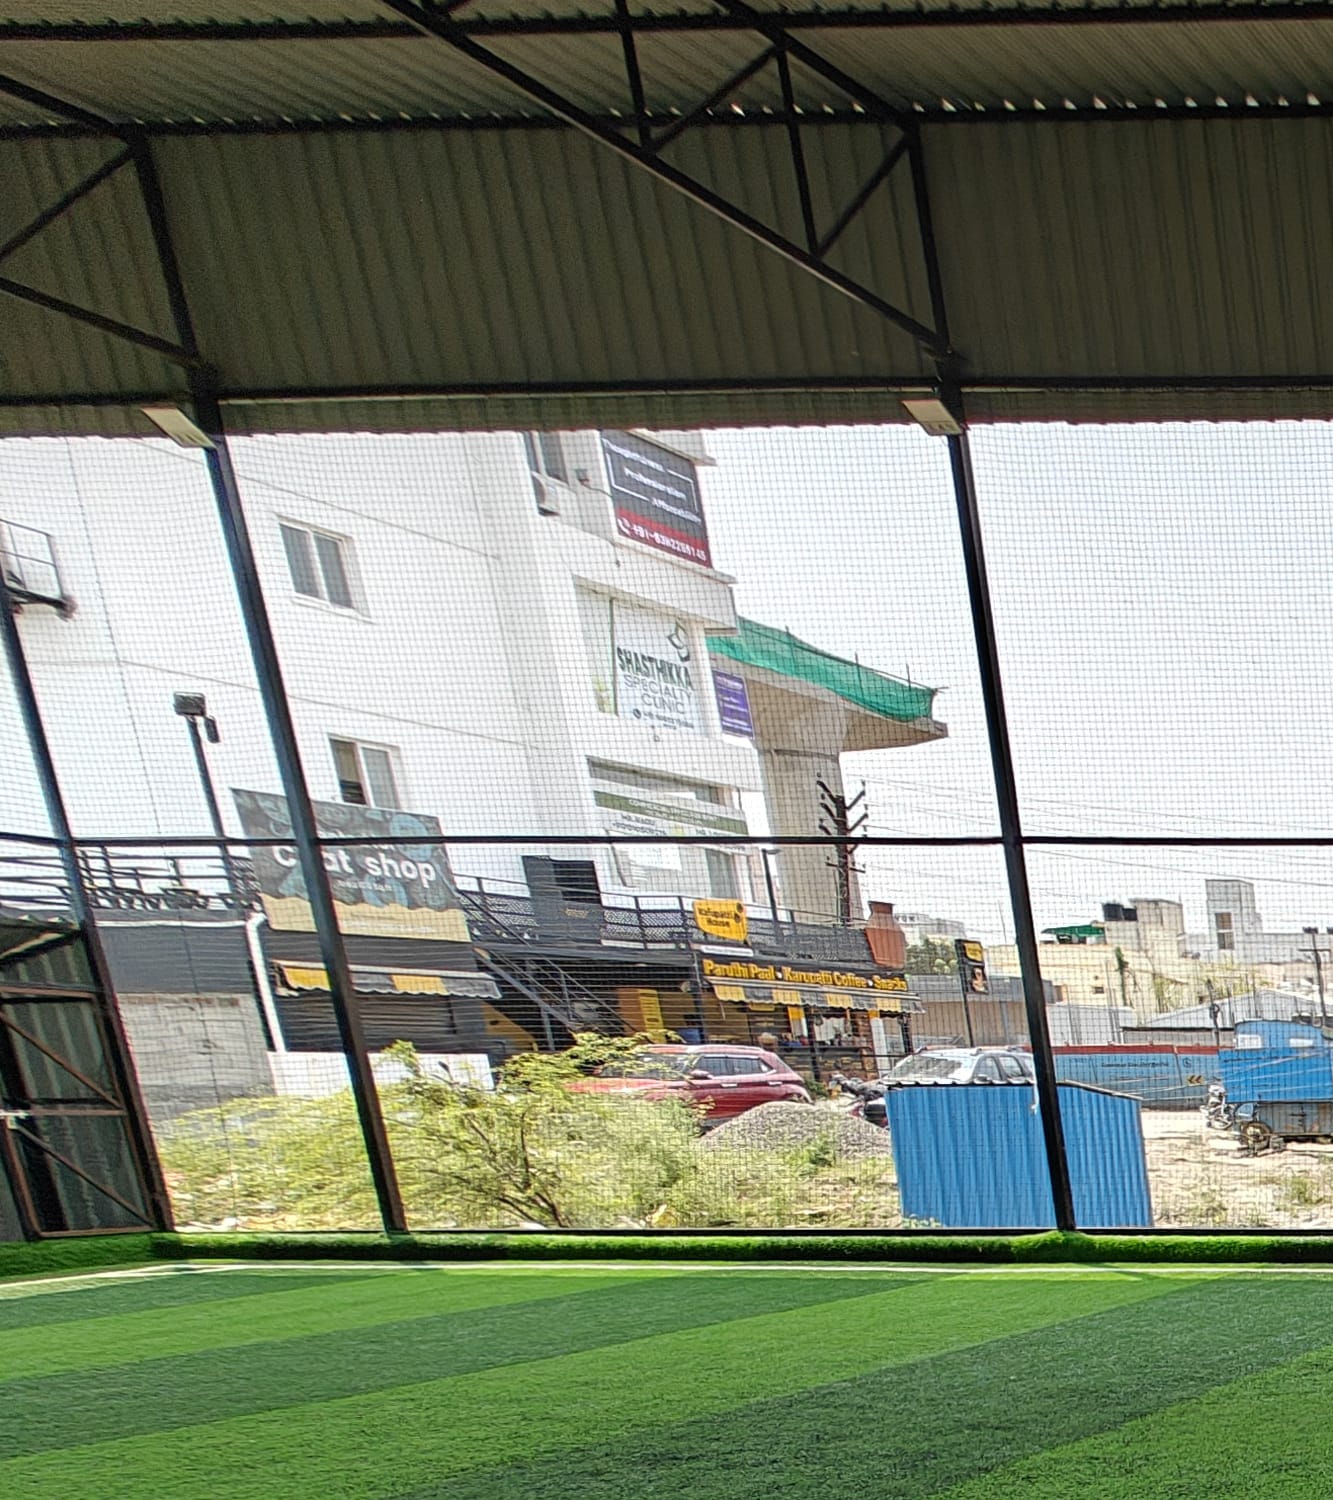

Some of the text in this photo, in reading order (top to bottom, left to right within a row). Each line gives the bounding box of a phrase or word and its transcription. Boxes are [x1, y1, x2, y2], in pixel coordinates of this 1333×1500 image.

[364, 852, 437, 889] shop
[703, 959, 748, 978] Paruthi
[750, 964, 776, 981] Paal
[834, 971, 868, 988] Coffee
[872, 974, 908, 992] Snacks
